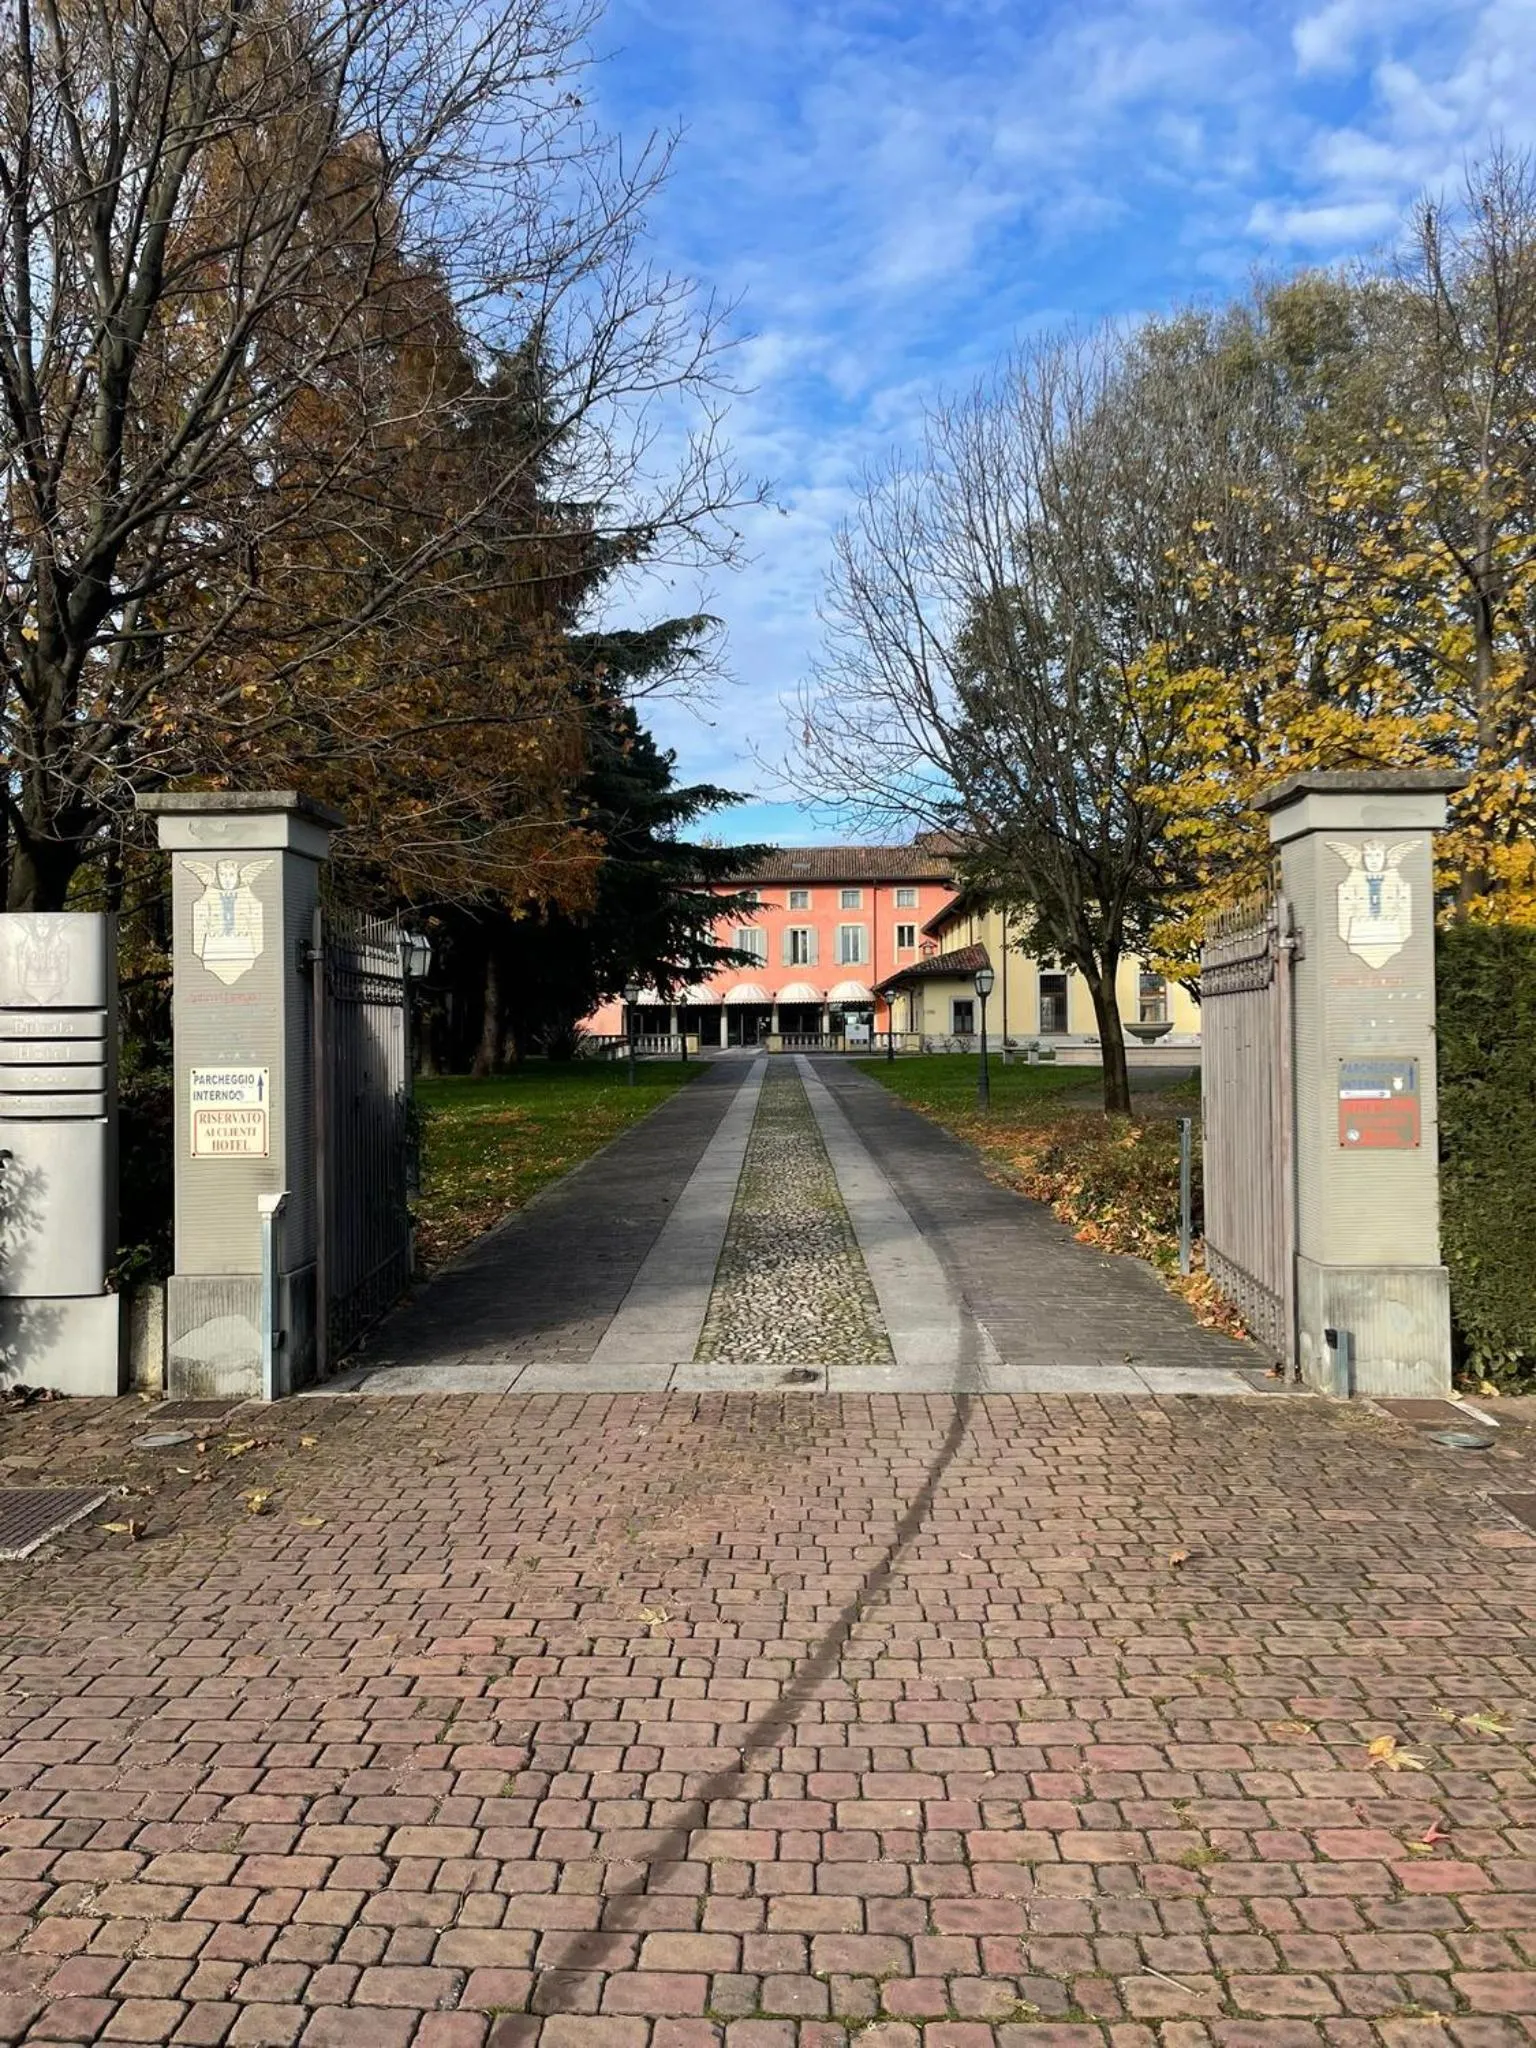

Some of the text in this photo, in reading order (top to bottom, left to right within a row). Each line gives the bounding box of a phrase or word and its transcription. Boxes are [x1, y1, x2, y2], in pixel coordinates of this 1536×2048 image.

[193, 1074, 254, 1085] PARCHEGGIO
[199, 1113, 261, 1124] RISERVATO
[217, 1128, 256, 1137] CLIENTI
[212, 1140, 249, 1151] HOTEL
